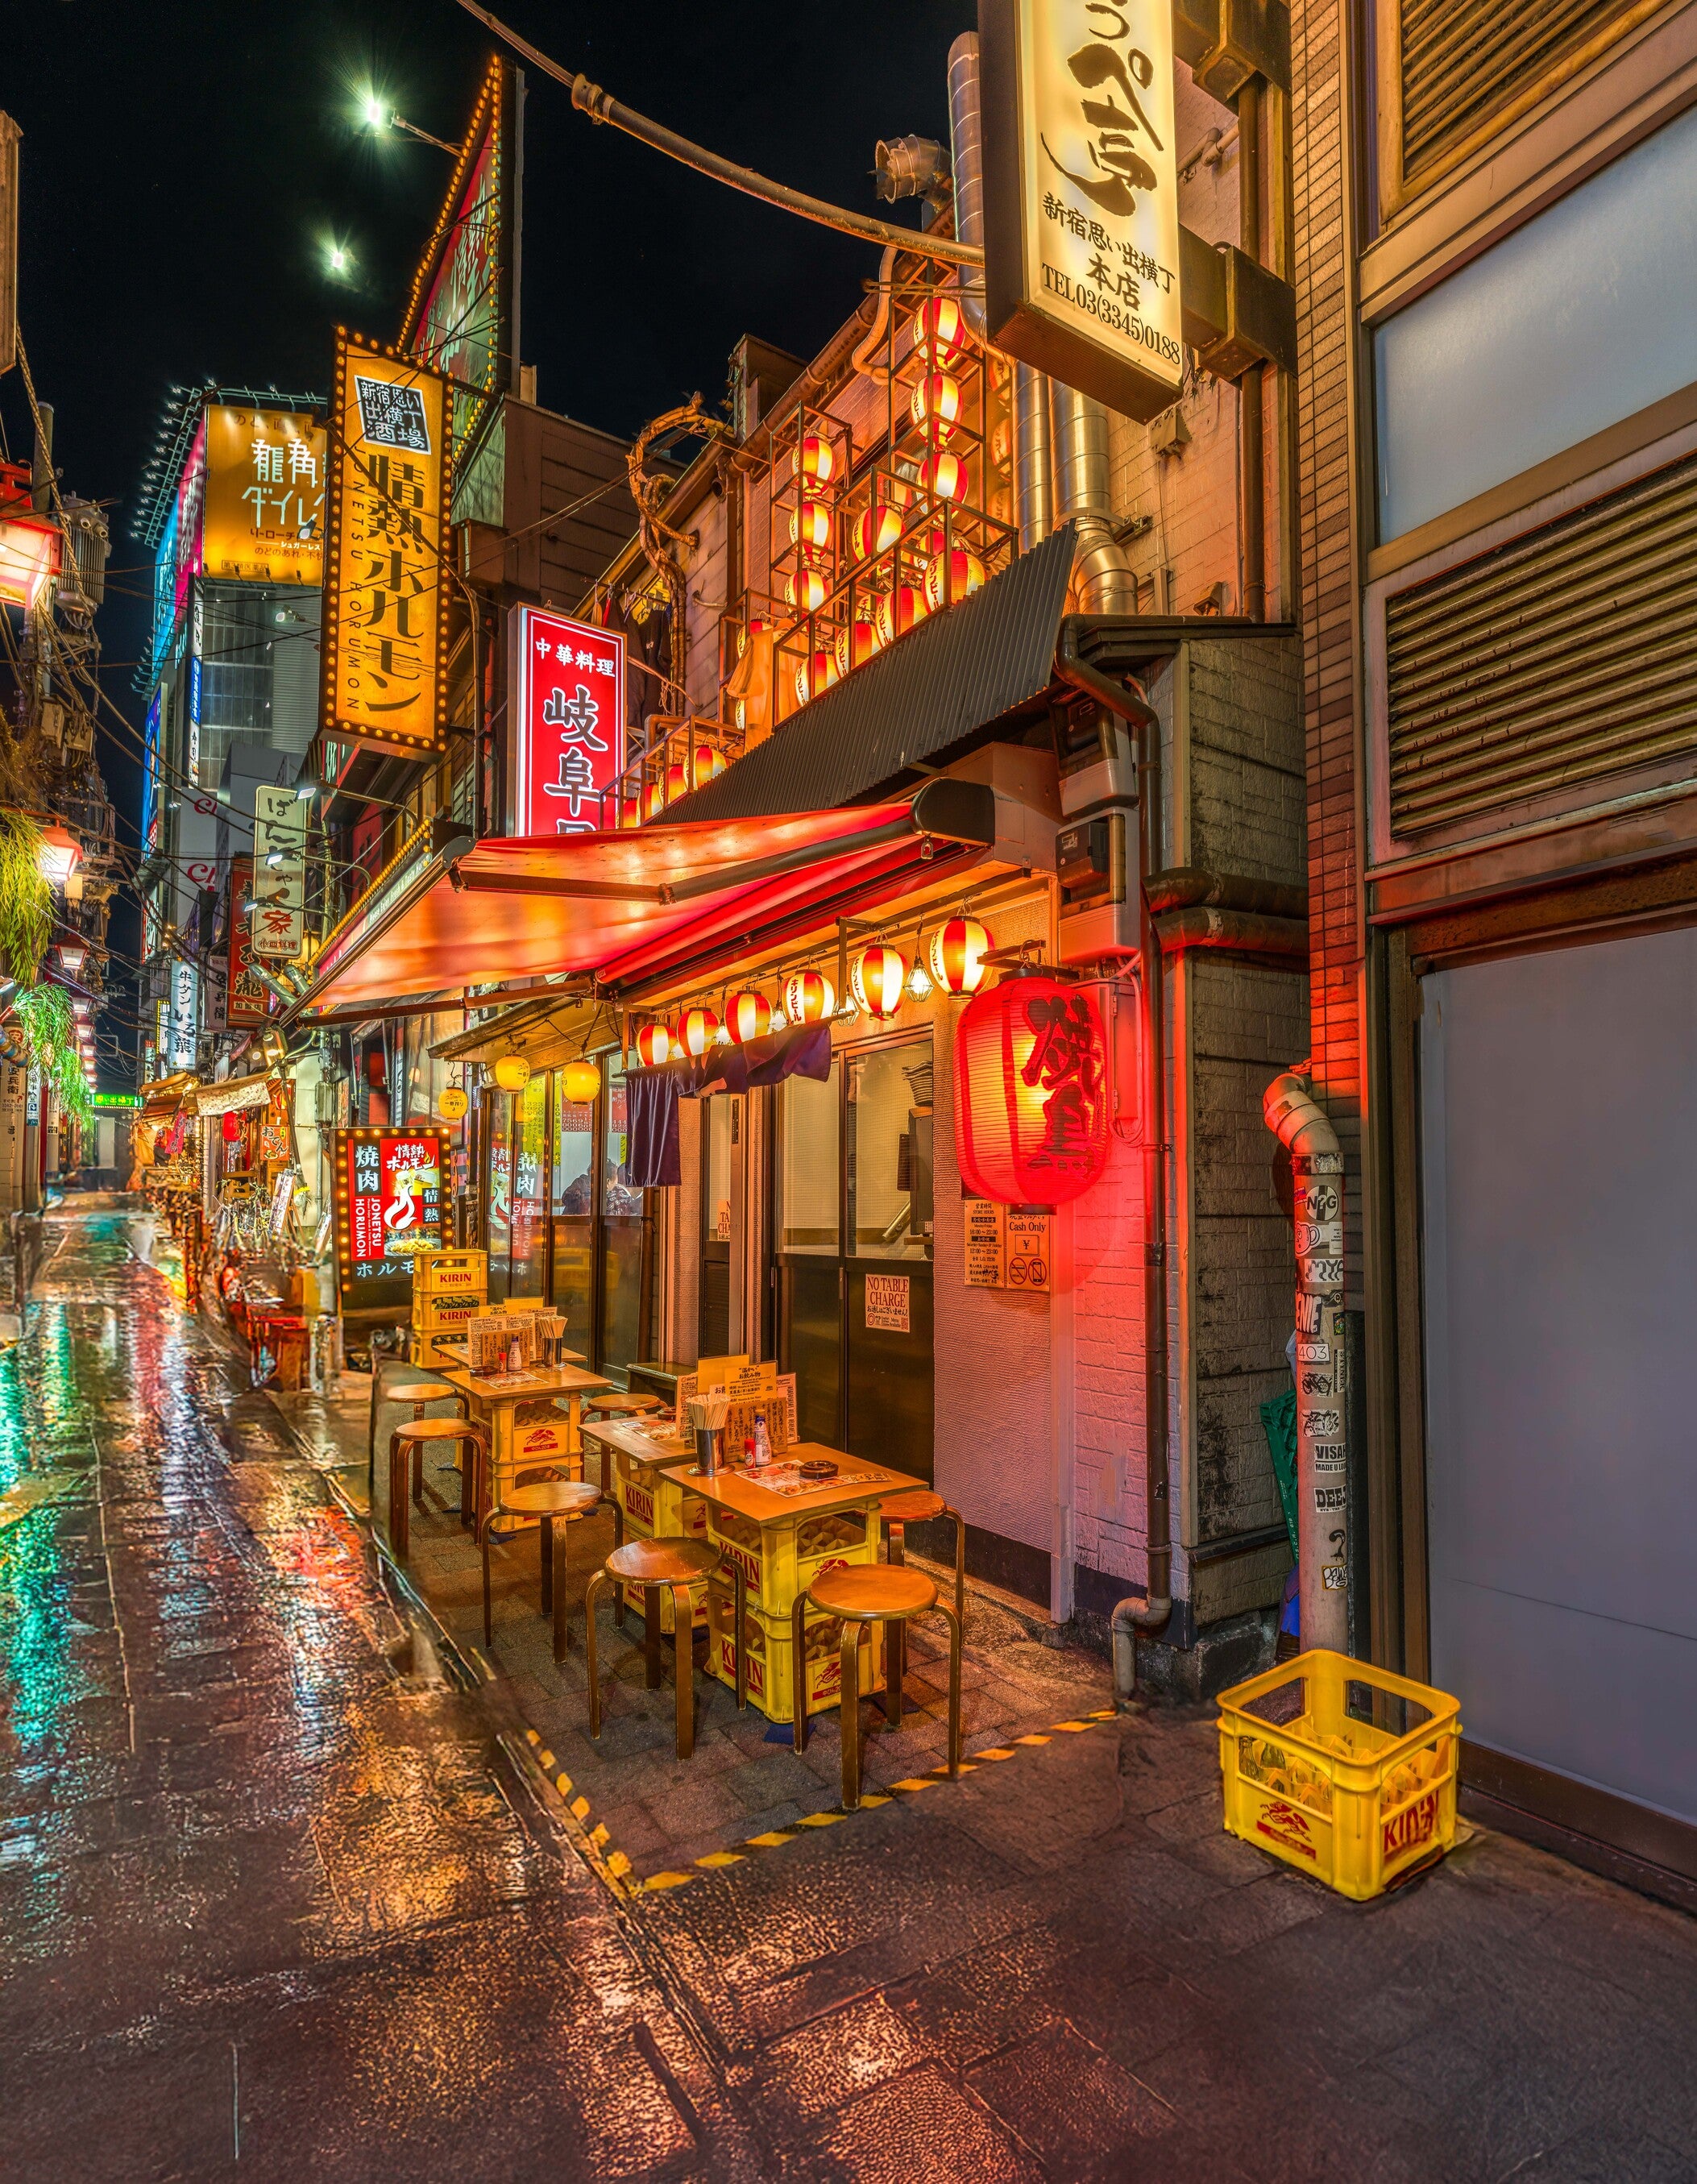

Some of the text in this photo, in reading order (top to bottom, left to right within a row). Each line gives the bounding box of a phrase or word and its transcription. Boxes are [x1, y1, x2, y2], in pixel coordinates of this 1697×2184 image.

[1042, 192, 1176, 295] 新宿思い出横丁
[1086, 254, 1141, 313] 本店
[360, 380, 420, 409] 新宿思い
[365, 400, 423, 429] 出横丁
[366, 421, 425, 449] 酒場
[251, 438, 326, 488] 龍角
[346, 446, 366, 710] JONETSU HORUMON
[362, 454, 425, 712] 情熱ホルモン
[535, 637, 616, 678] 中華料理
[179, 970, 193, 1005] 牛タン
[790, 978, 802, 1022] キリンビール
[262, 1126, 288, 1152] おでん
[395, 1143, 425, 1159] 情熱
[355, 1145, 380, 1193] 焼肉
[386, 1155, 436, 1173] ホルモン
[371, 1198, 382, 1247] JONETSU
[424, 1189, 439, 1223] 情熱
[355, 1198, 367, 1257] HORUMON
[1009, 1221, 1047, 1233] Cash Only
[440, 1273, 472, 1283] KIRIN
[867, 1277, 909, 1293] NO TABLE
[440, 1310, 472, 1320] KIRIN
[870, 1291, 906, 1308] CHARGE
[1299, 1345, 1328, 1360] 403
[1315, 1463, 1333, 1472] MADE
[1334, 1463, 1338, 1471] U
[625, 1484, 654, 1521] KIRIN
[721, 1639, 763, 1687] KIIN
